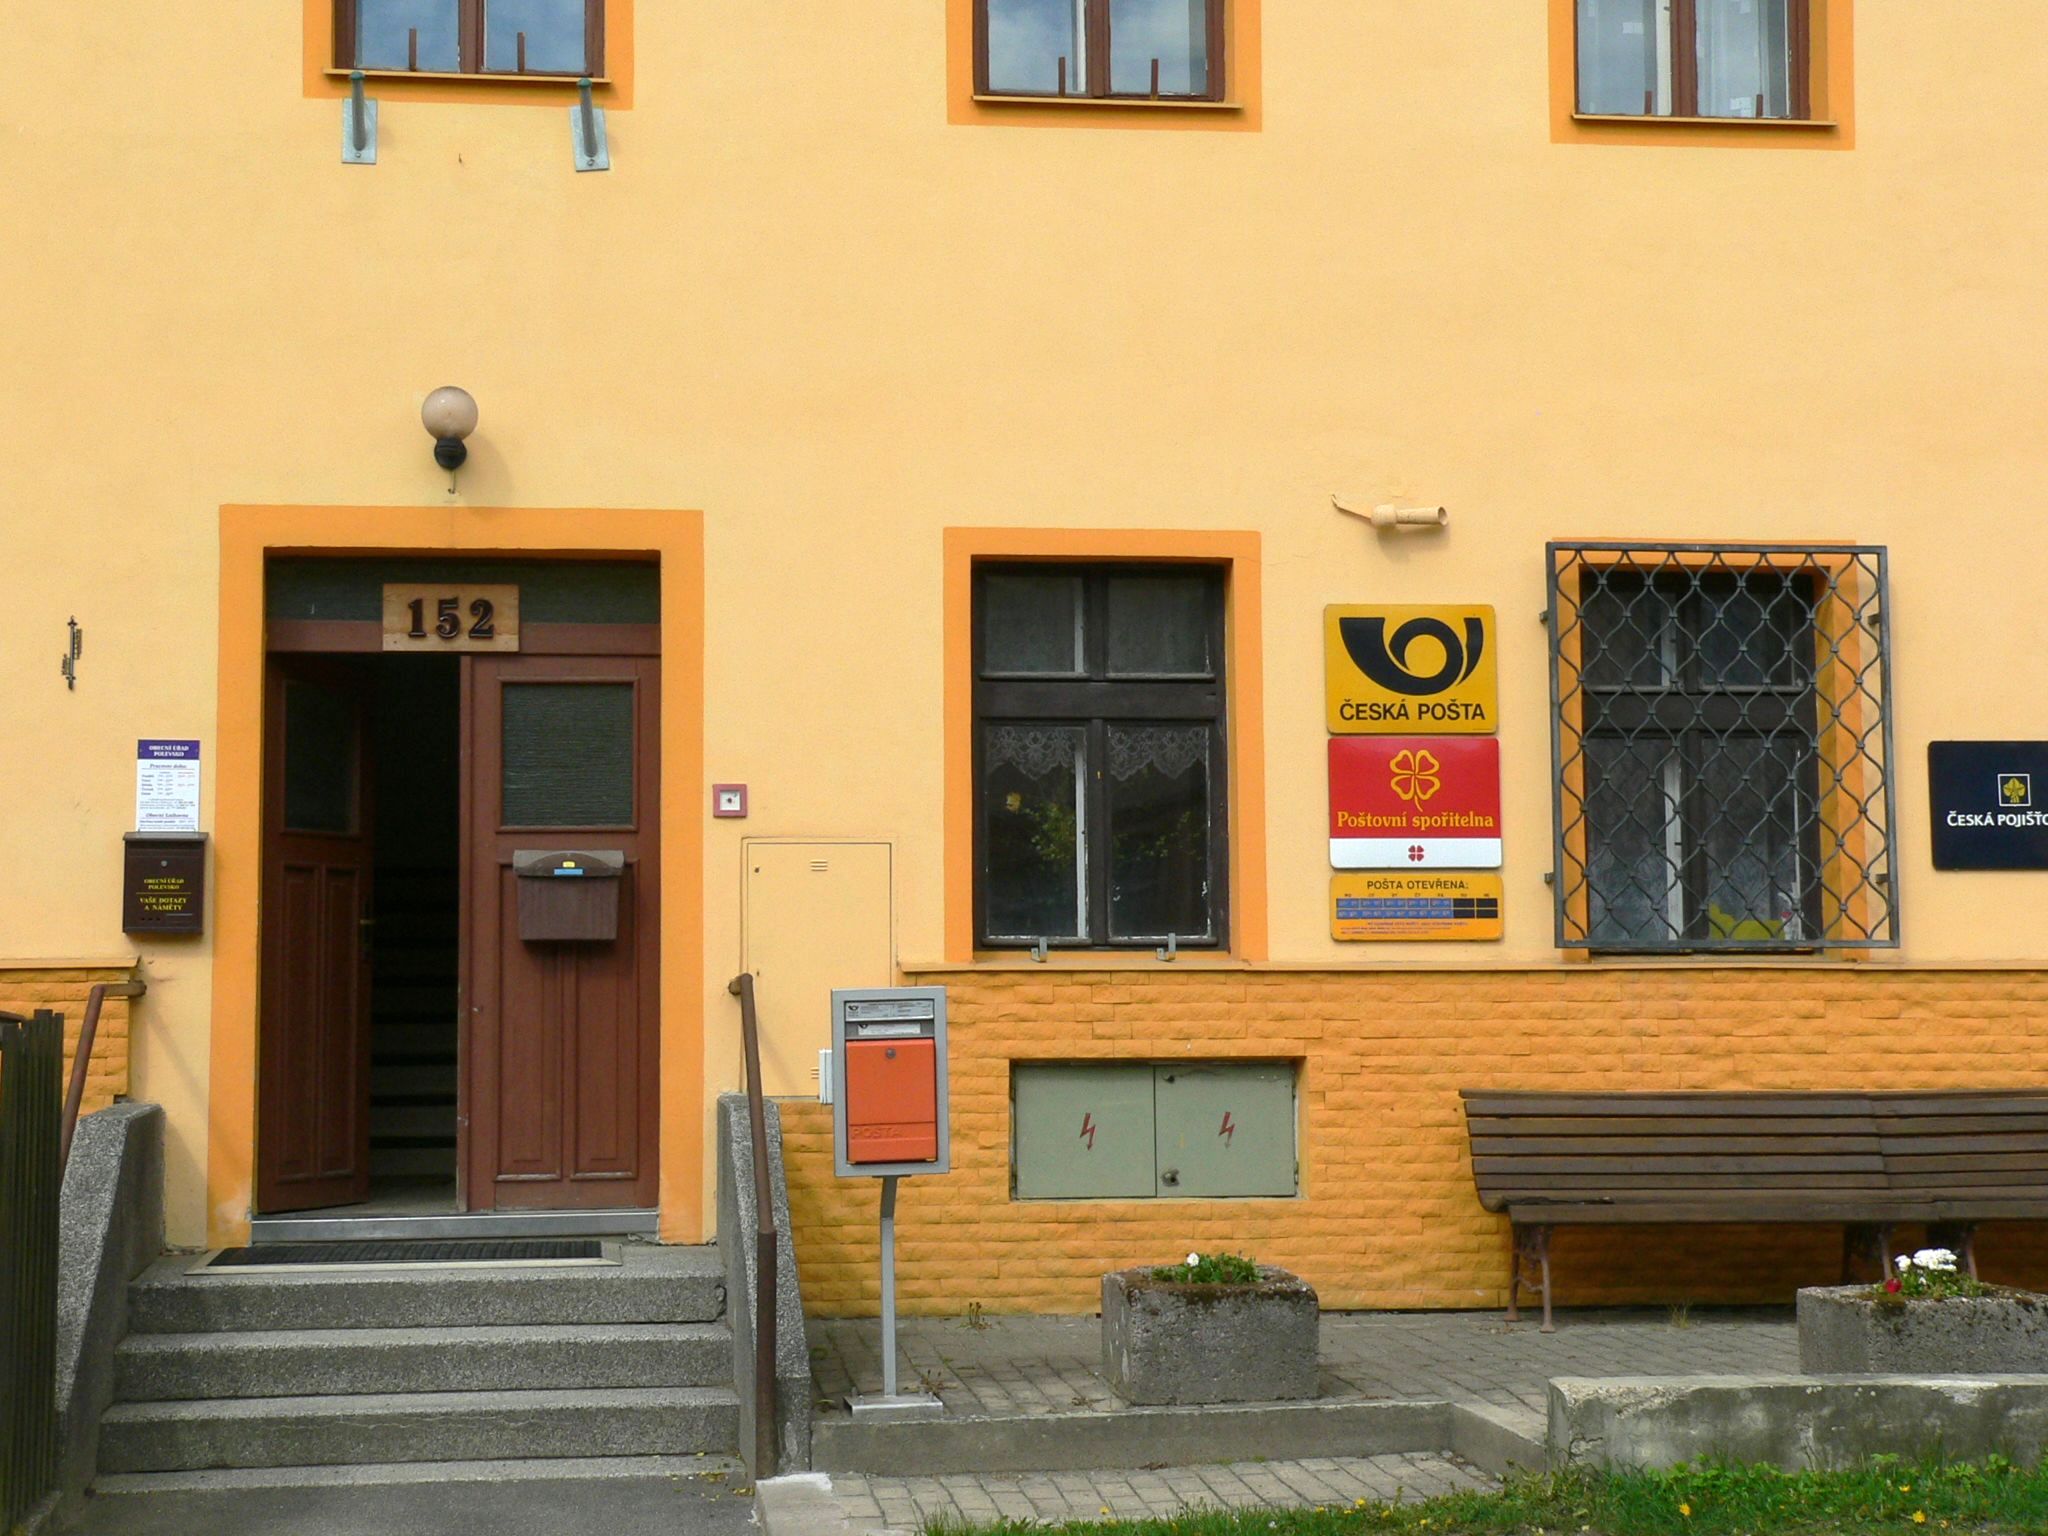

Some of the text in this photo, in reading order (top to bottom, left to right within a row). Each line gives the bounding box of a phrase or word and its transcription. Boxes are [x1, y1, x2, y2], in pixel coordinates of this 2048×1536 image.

[407, 596, 495, 639] 152
[1340, 699, 1485, 720] ČESKÁ POŠTA
[1338, 810, 1494, 831] Poštovní spořitelna
[1947, 811, 1995, 826] ČESKÁ
[1367, 878, 1468, 889] POŠTA OTEVŘENA:
